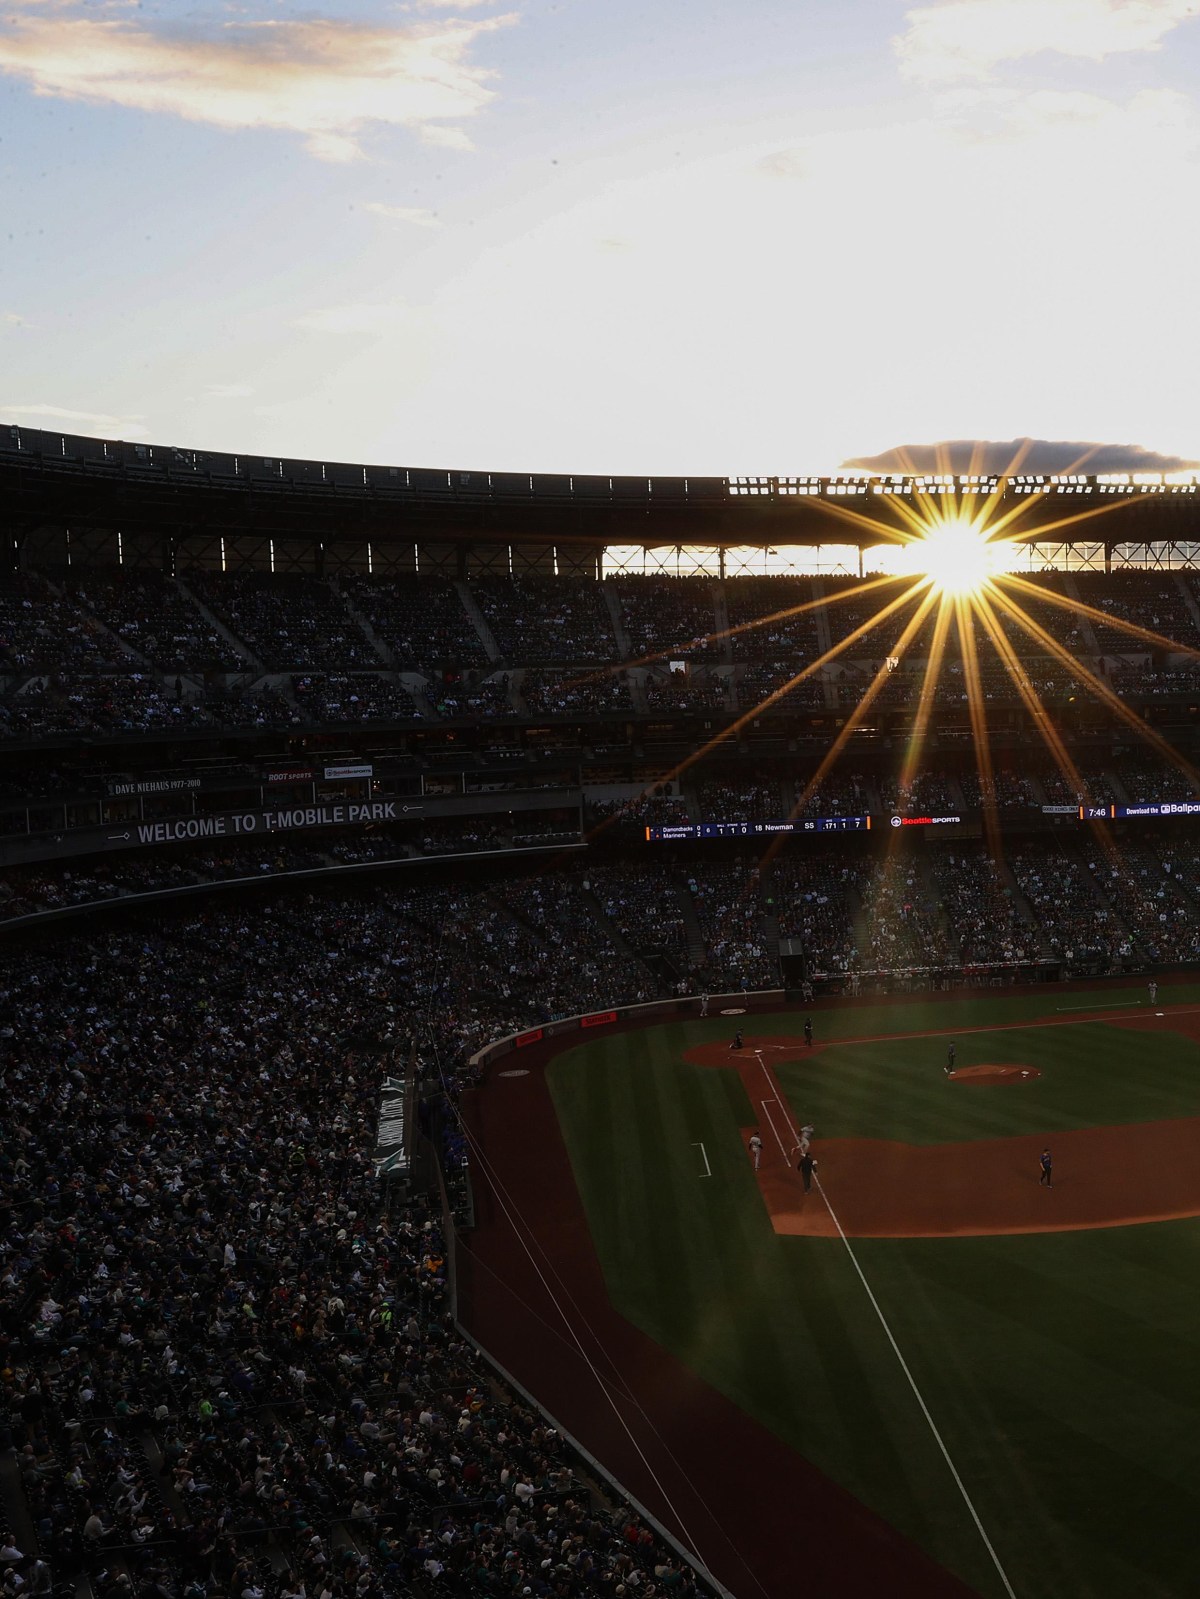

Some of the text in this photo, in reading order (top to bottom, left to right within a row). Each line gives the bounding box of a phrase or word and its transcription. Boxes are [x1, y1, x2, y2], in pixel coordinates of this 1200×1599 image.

[268, 773, 288, 781] ROOT
[116, 784, 136, 794] DAVE
[137, 781, 170, 793] NIEHAUS
[137, 802, 398, 844] WELCOME TO T-MOBILE PARK
